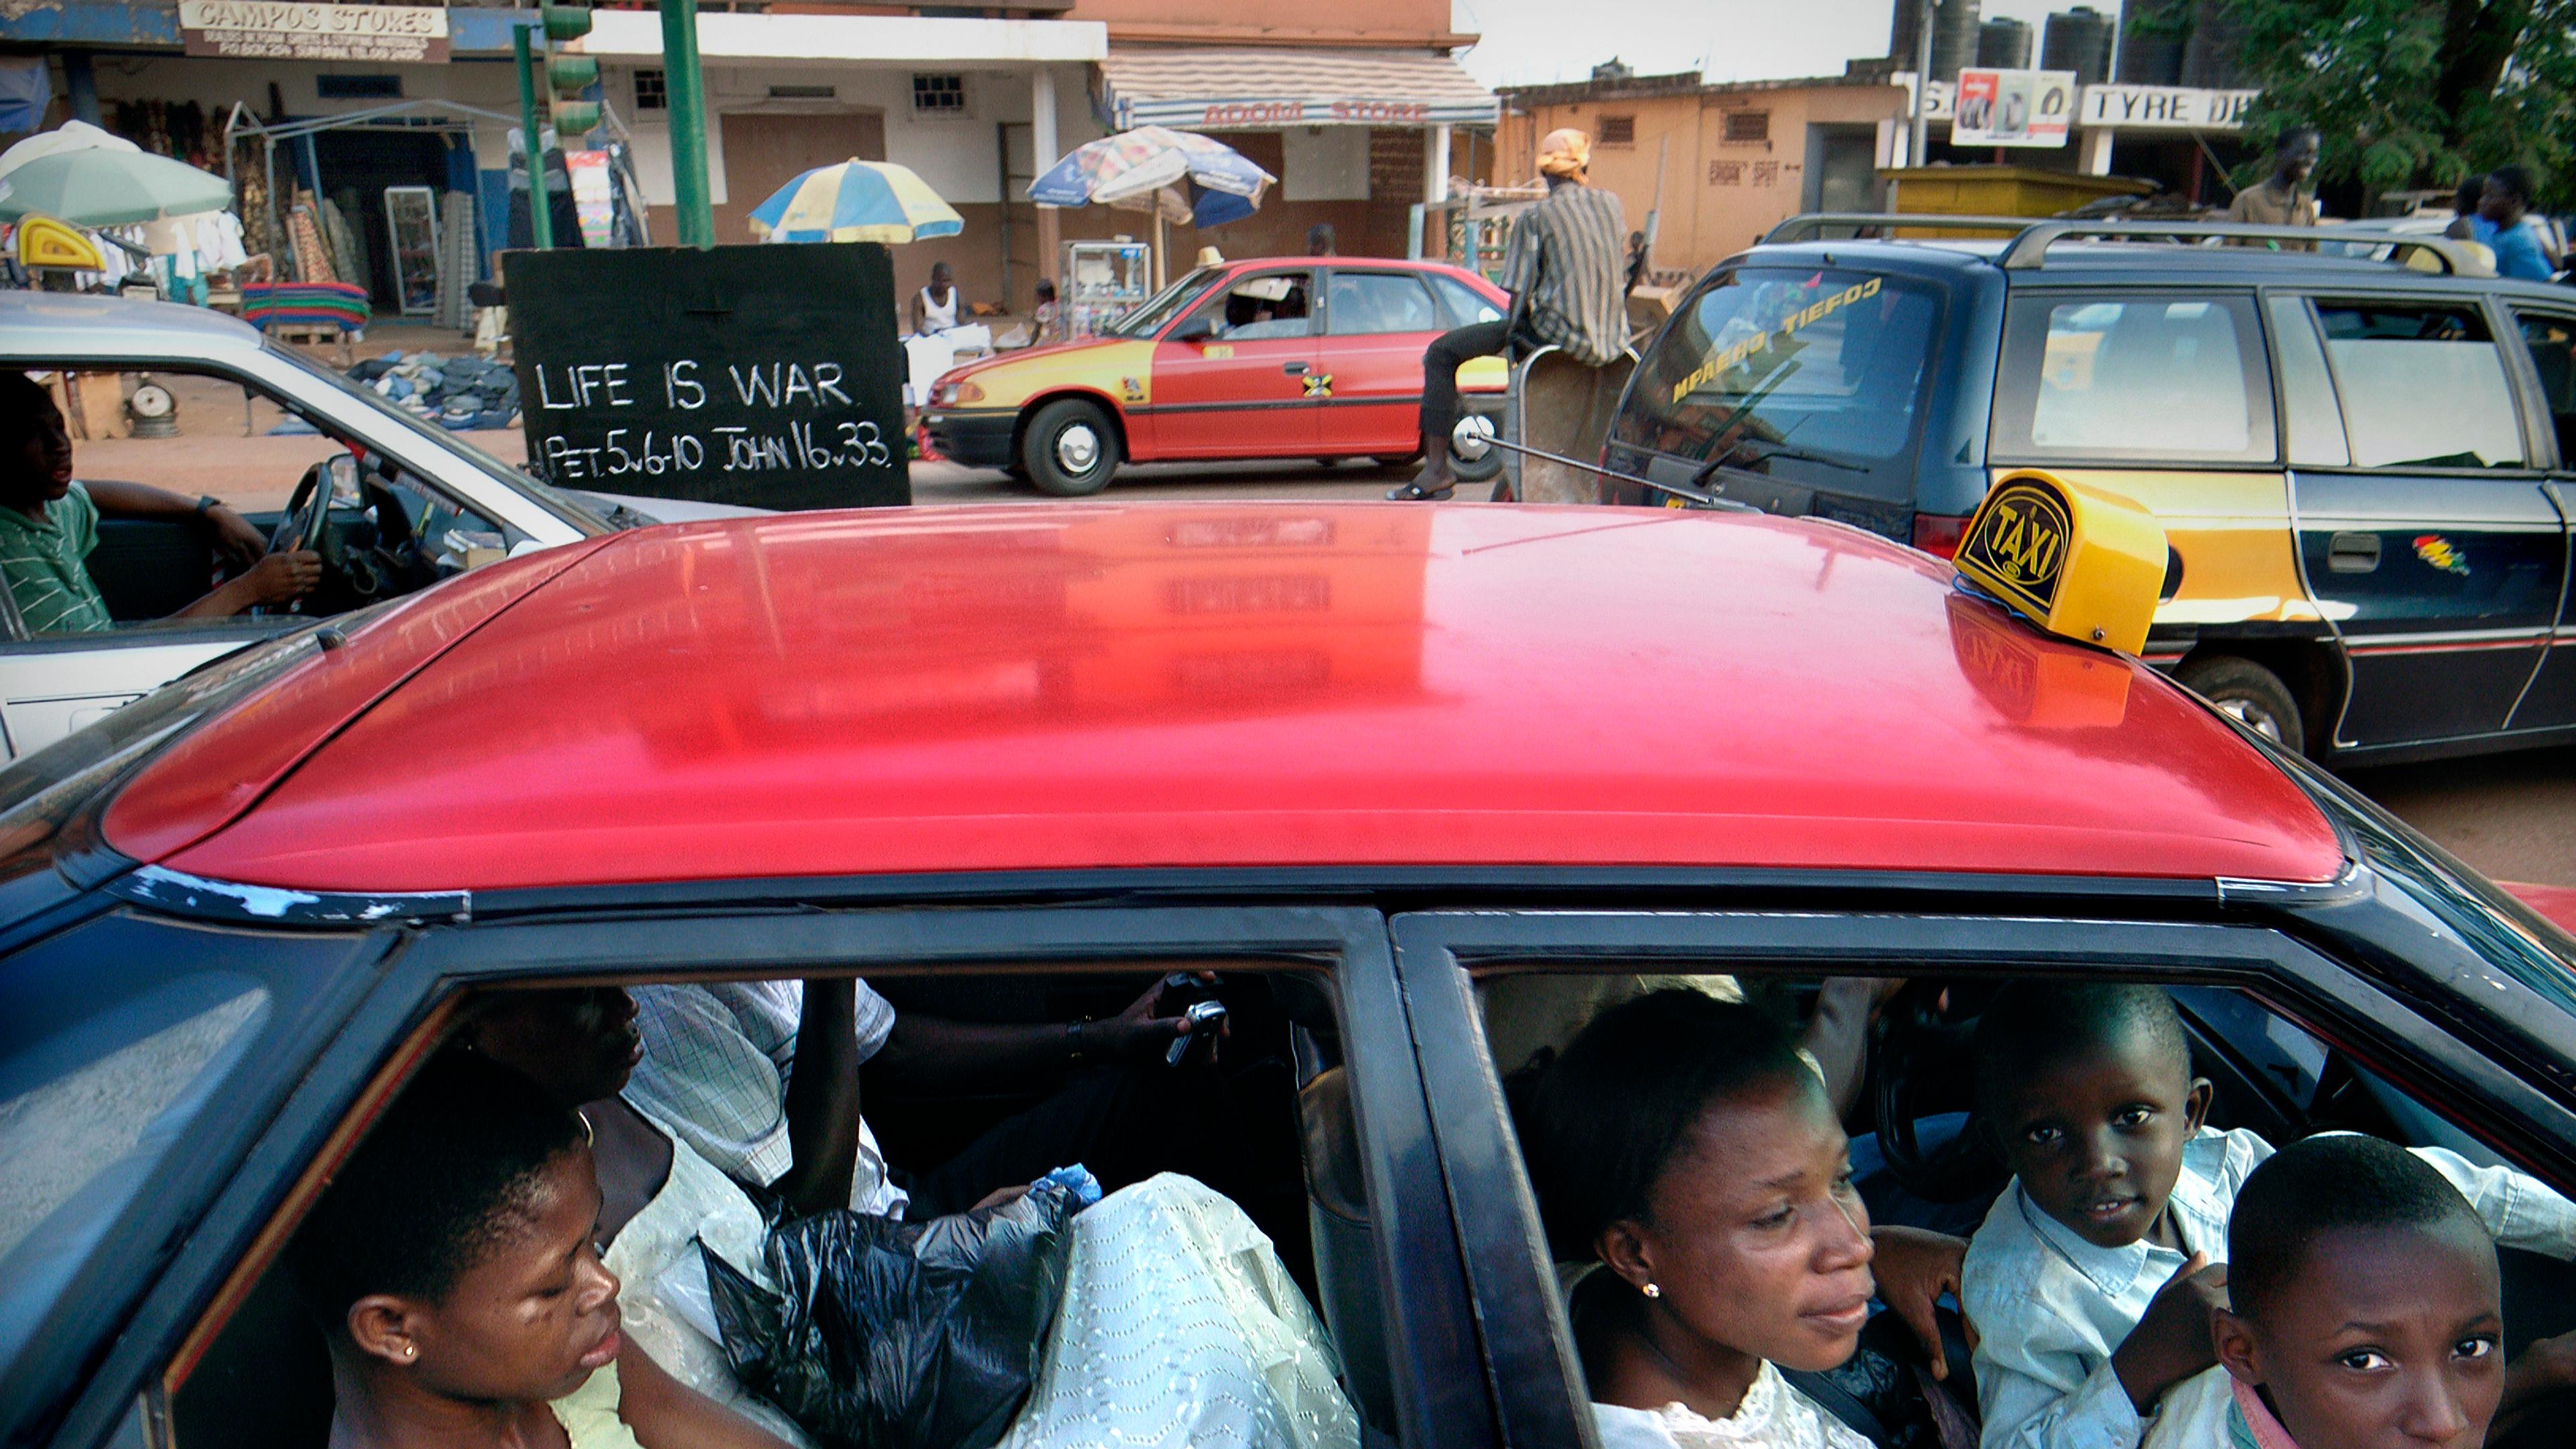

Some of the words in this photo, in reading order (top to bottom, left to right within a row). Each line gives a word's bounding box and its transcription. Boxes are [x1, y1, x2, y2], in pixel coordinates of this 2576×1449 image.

[200, 3, 320, 30] CAMPOS
[333, 9, 433, 33] STORES
[1201, 102, 1303, 125] ADOM
[1331, 101, 1431, 122] STORE
[2094, 91, 2189, 121] TYRE
[536, 362, 633, 409] LIFE
[665, 360, 706, 409] IS
[711, 427, 792, 470] JOHN
[1992, 504, 2060, 580] TAXI
